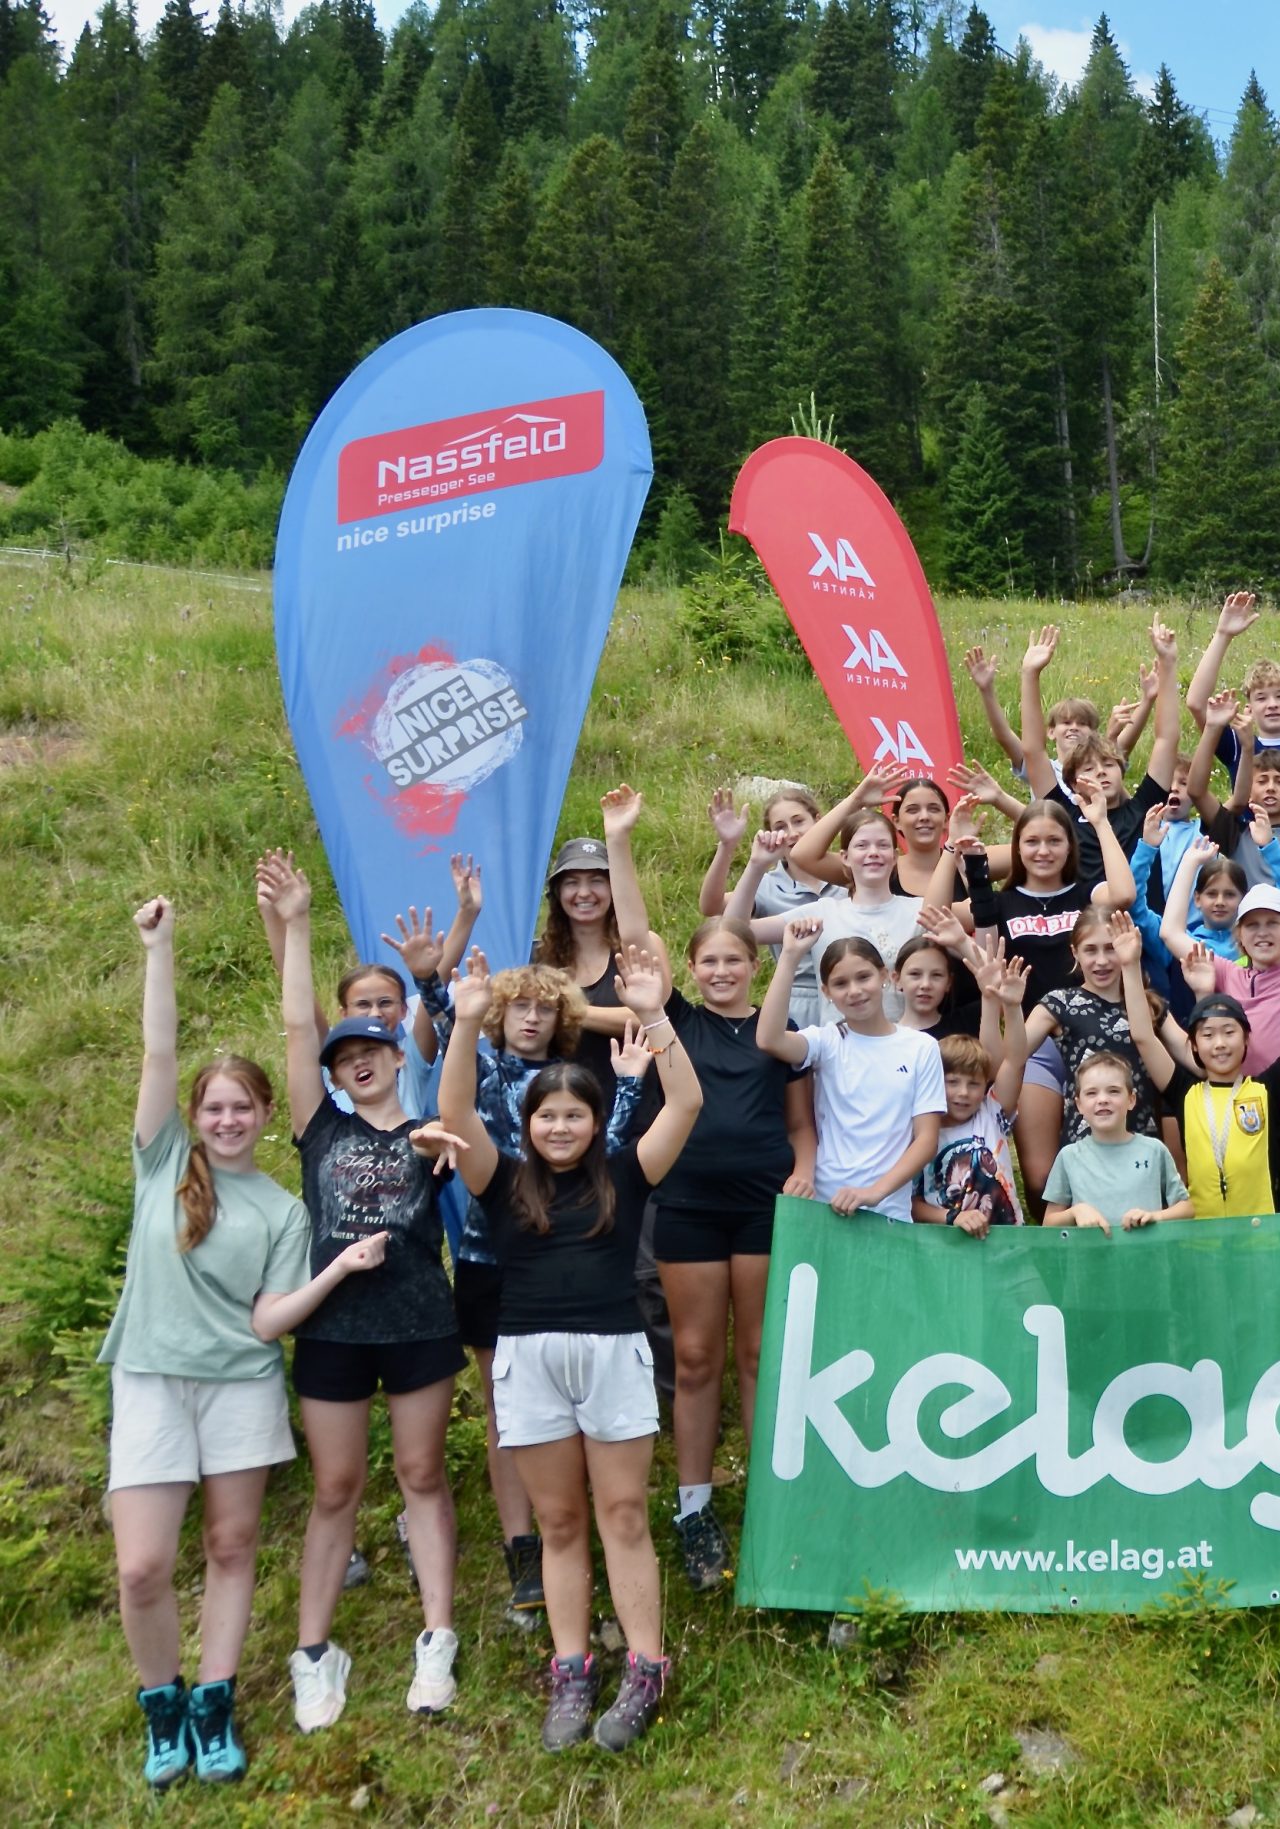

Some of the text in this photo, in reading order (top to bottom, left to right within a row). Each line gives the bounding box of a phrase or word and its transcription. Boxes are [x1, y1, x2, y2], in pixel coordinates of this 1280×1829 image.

[378, 421, 566, 488] Nassfeld
[378, 472, 496, 506] Pressegger See
[337, 502, 497, 552] nice surprise
[398, 678, 476, 740] NICE
[387, 689, 528, 786] SURPRISE
[955, 1539, 1214, 1580] www.kelag.at
